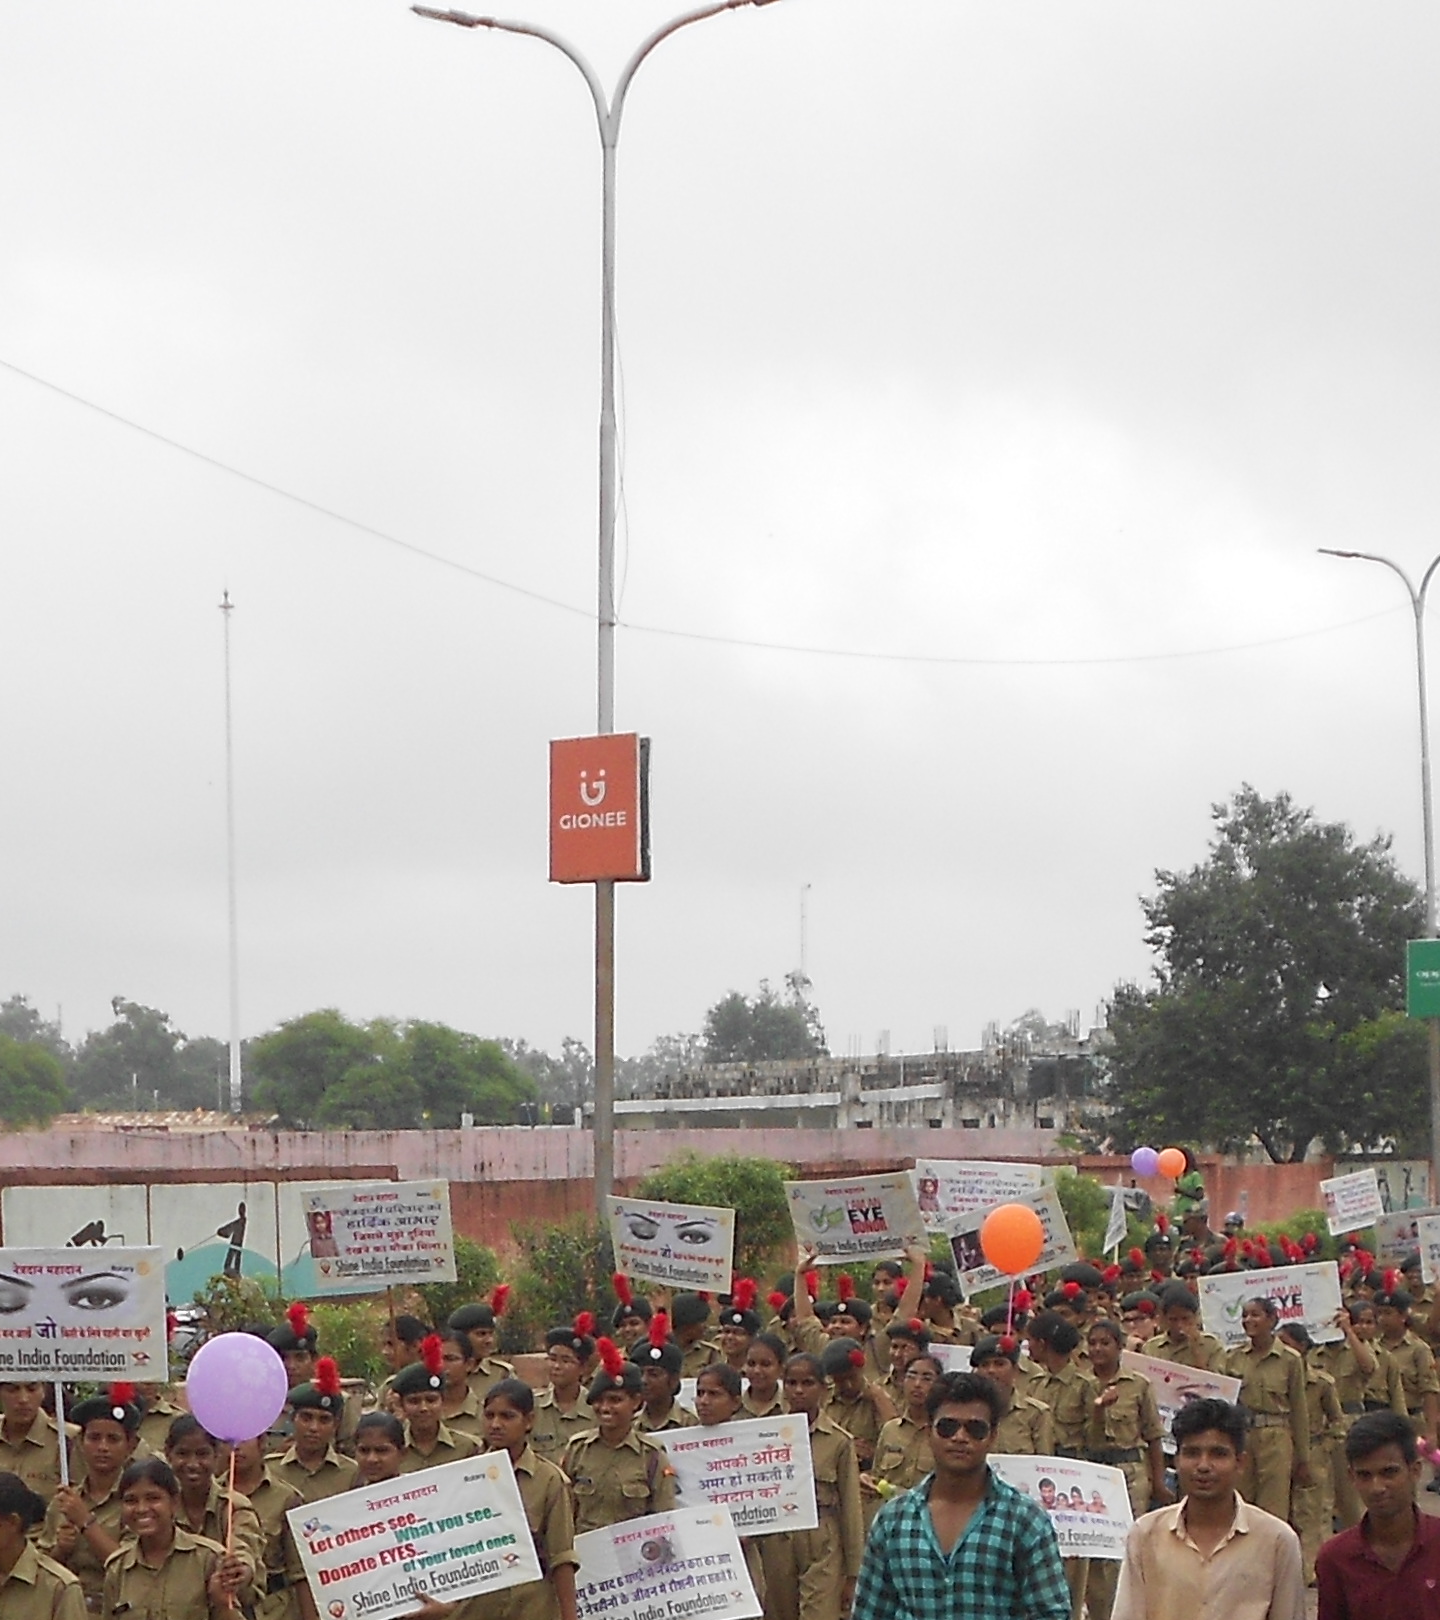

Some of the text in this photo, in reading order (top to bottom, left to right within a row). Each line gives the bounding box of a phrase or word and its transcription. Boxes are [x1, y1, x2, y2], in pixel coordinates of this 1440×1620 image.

[559, 811, 627, 829] GIONEE
[848, 1206, 884, 1223] EYE
[35, 1315, 58, 1339] जो
[18, 1348, 51, 1366] India
[55, 1348, 126, 1366] Foundation
[706, 1453, 748, 1472] आपकी
[699, 1477, 726, 1490] अमर
[746, 1466, 782, 1483] सकती
[366, 1484, 438, 1512] नेत्रदान महादान
[731, 1504, 777, 1521] ndation
[309, 1537, 334, 1555] Let
[335, 1521, 387, 1547] others
[394, 1522, 435, 1543] What
[438, 1515, 464, 1533] you
[418, 1551, 448, 1571] your
[449, 1540, 485, 1560] loved
[486, 1532, 516, 1549] ones
[318, 1556, 378, 1586] Donate
[352, 1588, 391, 1611] Shine
[392, 1577, 428, 1603] India
[430, 1558, 500, 1588] Foundation
[599, 1578, 616, 1593] बाद
[667, 1592, 728, 1616] Foundation
